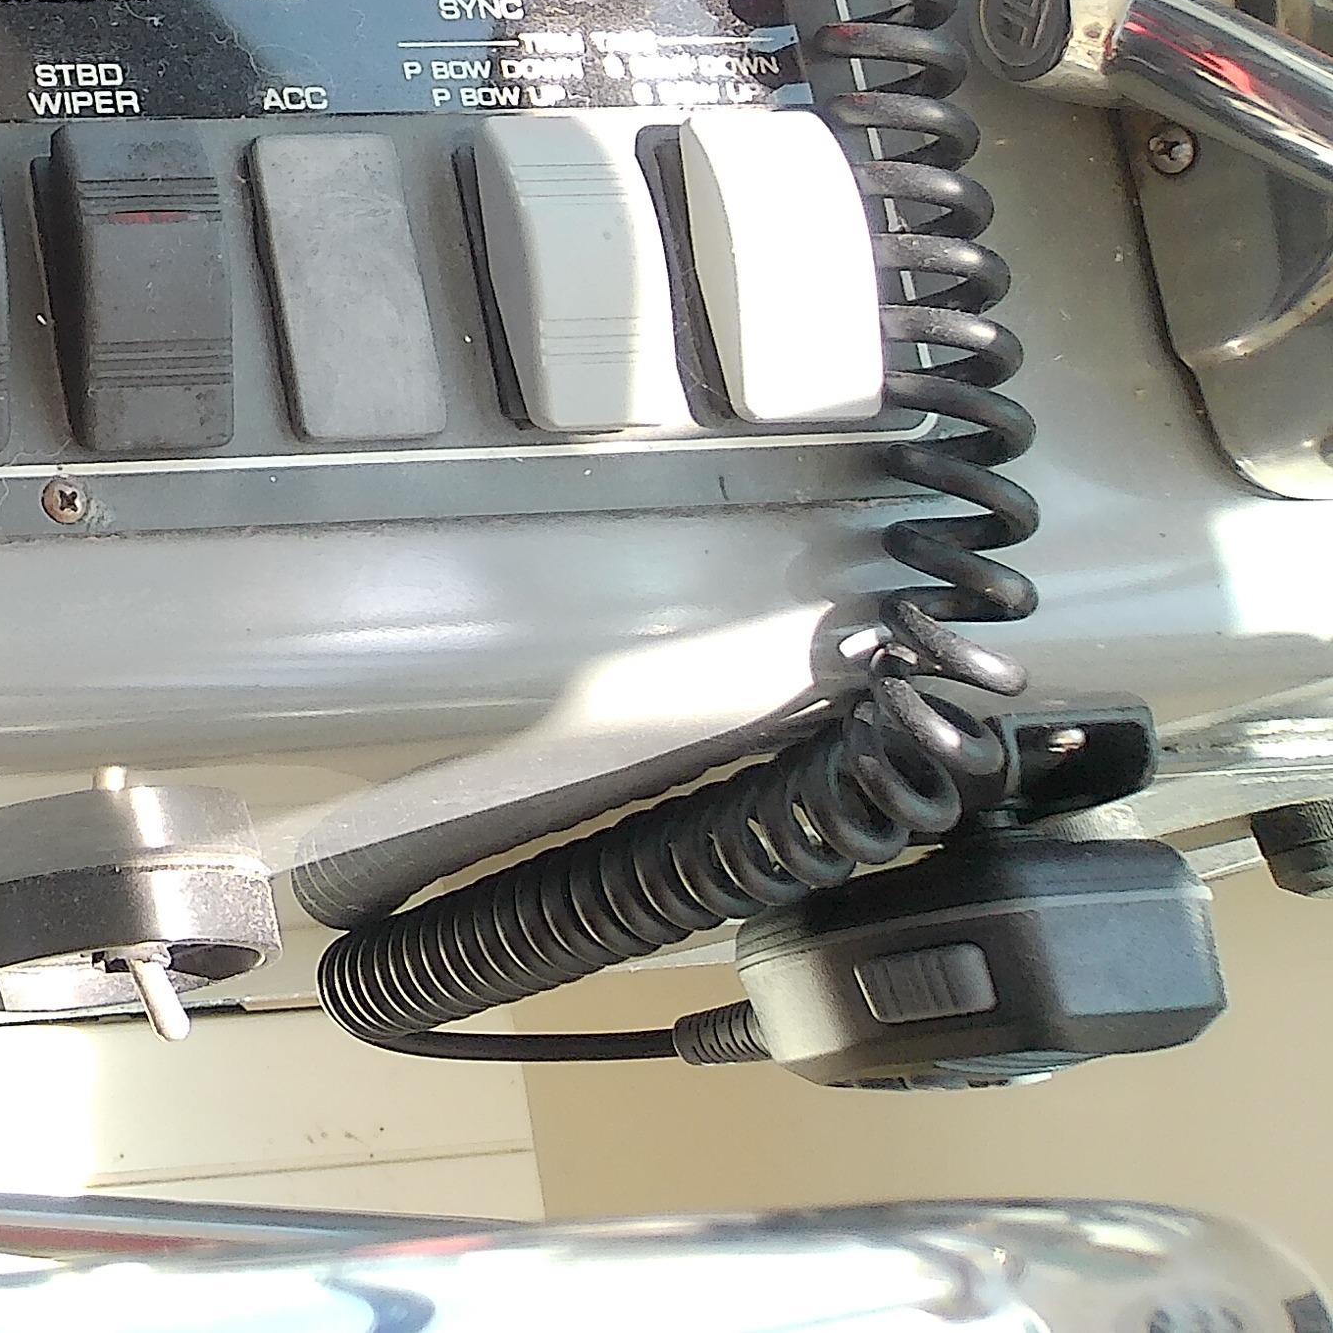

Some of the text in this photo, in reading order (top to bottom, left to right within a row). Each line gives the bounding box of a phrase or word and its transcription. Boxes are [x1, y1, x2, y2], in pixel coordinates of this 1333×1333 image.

[34, 64, 124, 88] STBD
[403, 61, 423, 80] P
[431, 60, 492, 79] BOW
[28, 91, 141, 115] WIPER
[263, 87, 328, 111] ACC
[431, 88, 451, 107] P
[460, 87, 521, 106] BOW
